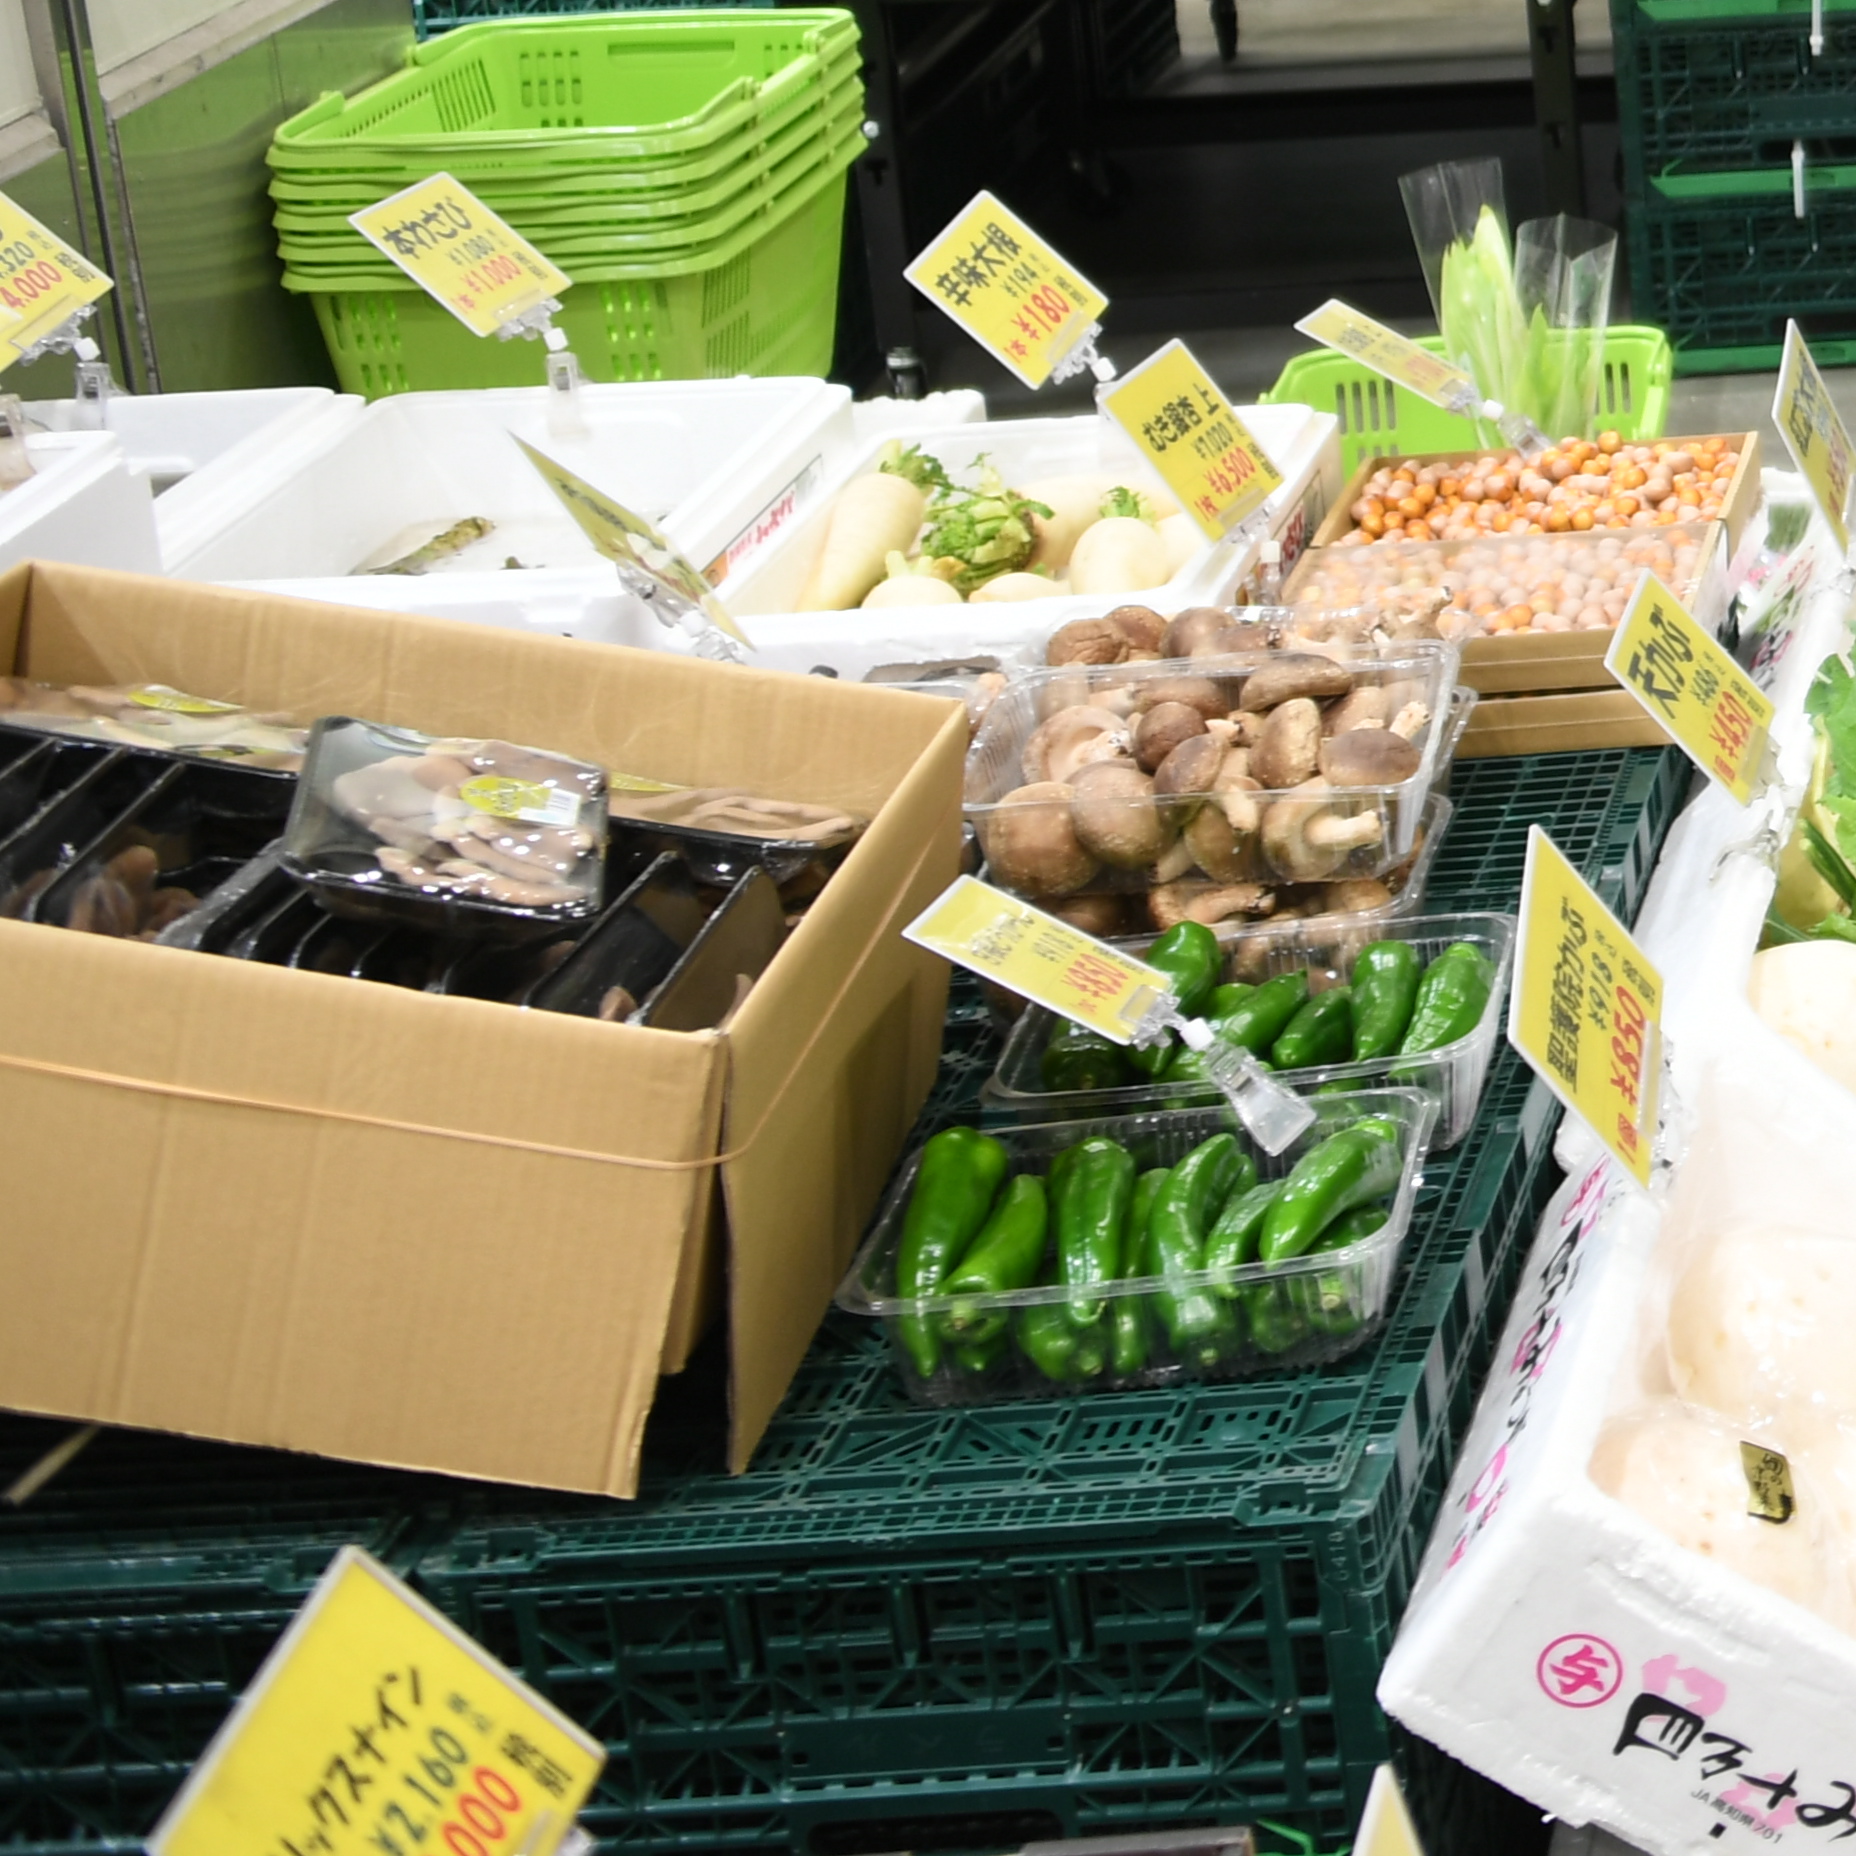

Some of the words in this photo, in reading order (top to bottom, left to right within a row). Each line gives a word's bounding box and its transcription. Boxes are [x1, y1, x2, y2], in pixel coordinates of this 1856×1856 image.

[382, 197, 473, 259] 本わさび
[935, 221, 1022, 307] 辛味大根
[1001, 261, 1040, 299] ¥194
[1010, 284, 1071, 341] ¥180
[1002, 338, 1029, 364] 1本
[1141, 394, 1204, 453] むき銀杏
[1192, 382, 1221, 416] 上
[1627, 602, 1694, 721] 天かぶ
[1709, 690, 1753, 761] ¥450
[1061, 951, 1130, 1001] ¥850
[1547, 896, 1588, 1094] 聖護院かぶ
[1588, 951, 1613, 1031] ¥918
[1610, 985, 1647, 1106] ¥850
